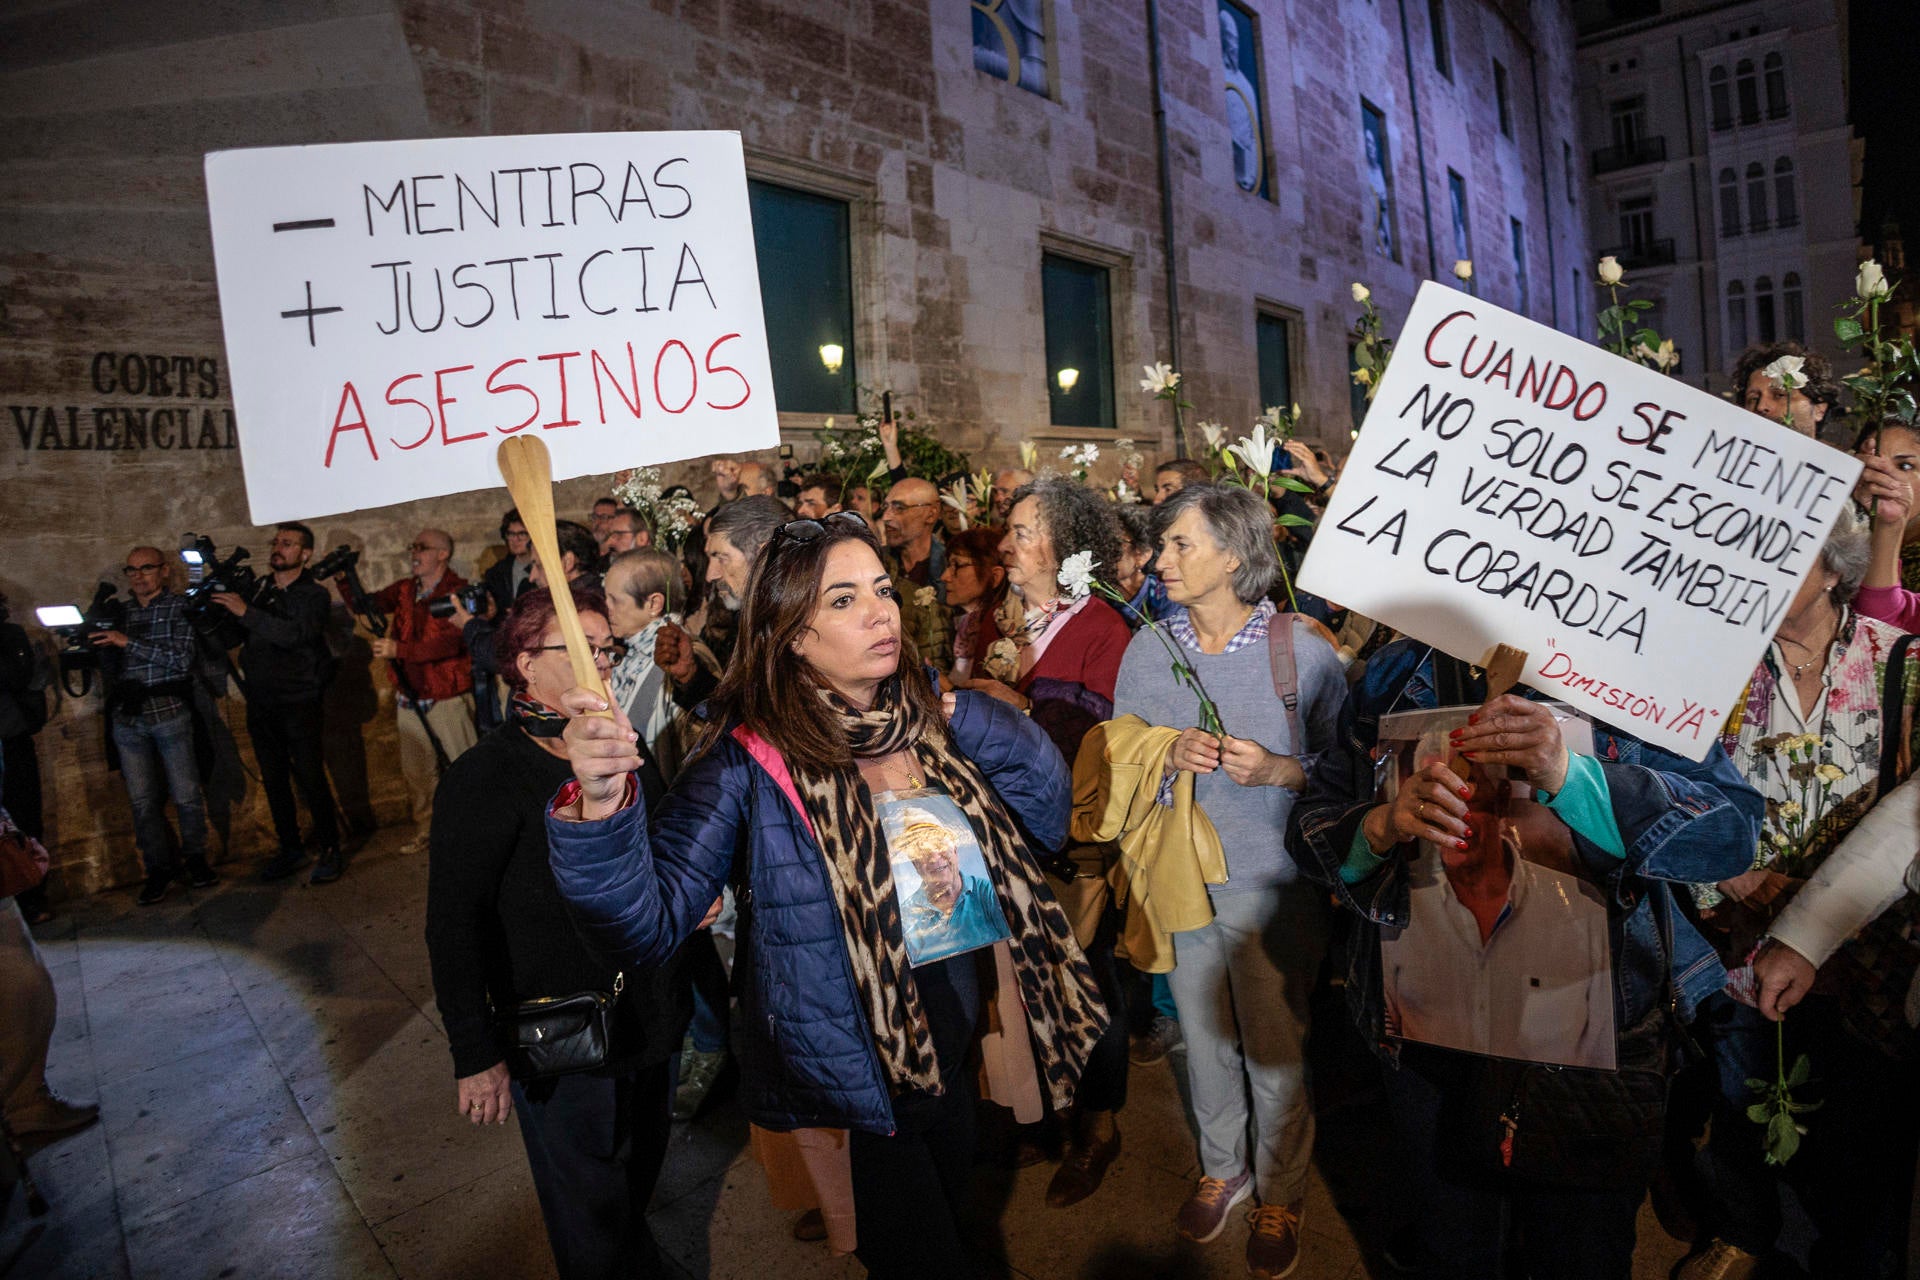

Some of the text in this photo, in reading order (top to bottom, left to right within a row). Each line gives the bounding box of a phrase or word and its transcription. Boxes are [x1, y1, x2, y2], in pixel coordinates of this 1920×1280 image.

[363, 157, 693, 237] MENTIRAS
[370, 242, 717, 336] JUSTICIA
[91, 351, 220, 399] CORTS
[324, 332, 752, 469] ASESINOS
[1424, 309, 1848, 524] CUANDO SE MIENTE
[1335, 494, 1408, 556] LA
[1374, 437, 1790, 635] LA VERDAD TAMBIEN
[1398, 383, 1817, 577] NO SOLO SE ESCONDE
